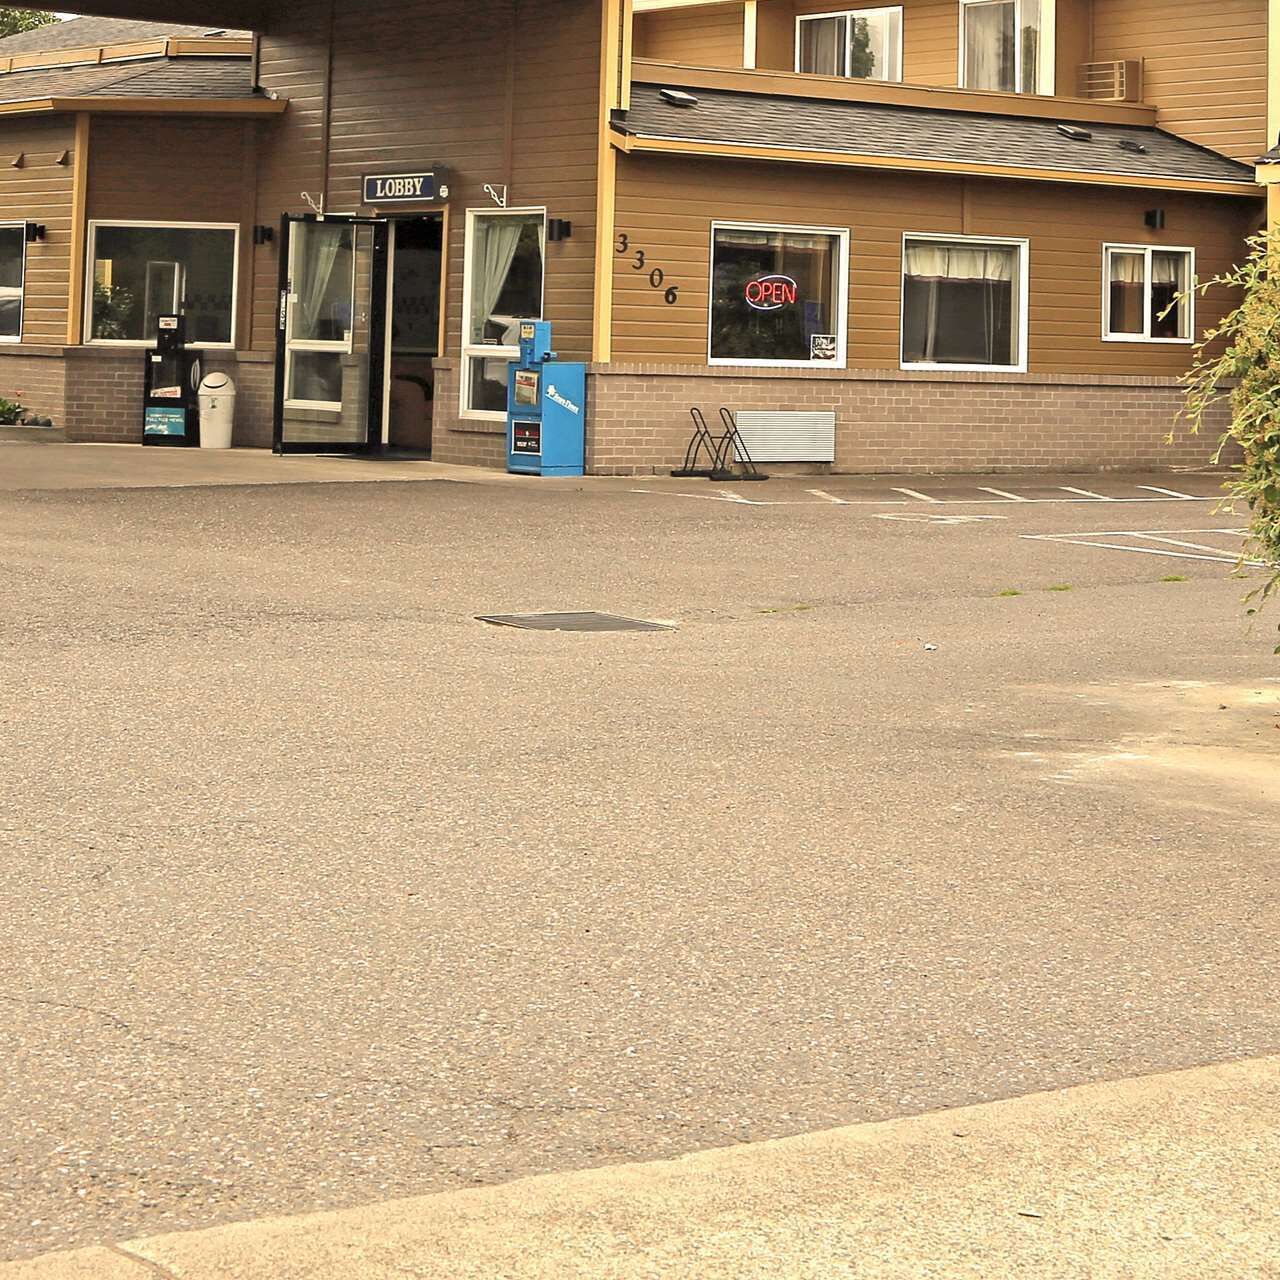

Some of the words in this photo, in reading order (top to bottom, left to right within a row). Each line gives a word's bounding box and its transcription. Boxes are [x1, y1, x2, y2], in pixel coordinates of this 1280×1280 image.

[375, 177, 424, 197] LOBBY
[615, 233, 678, 305] 3306
[745, 281, 796, 304] OPEN
